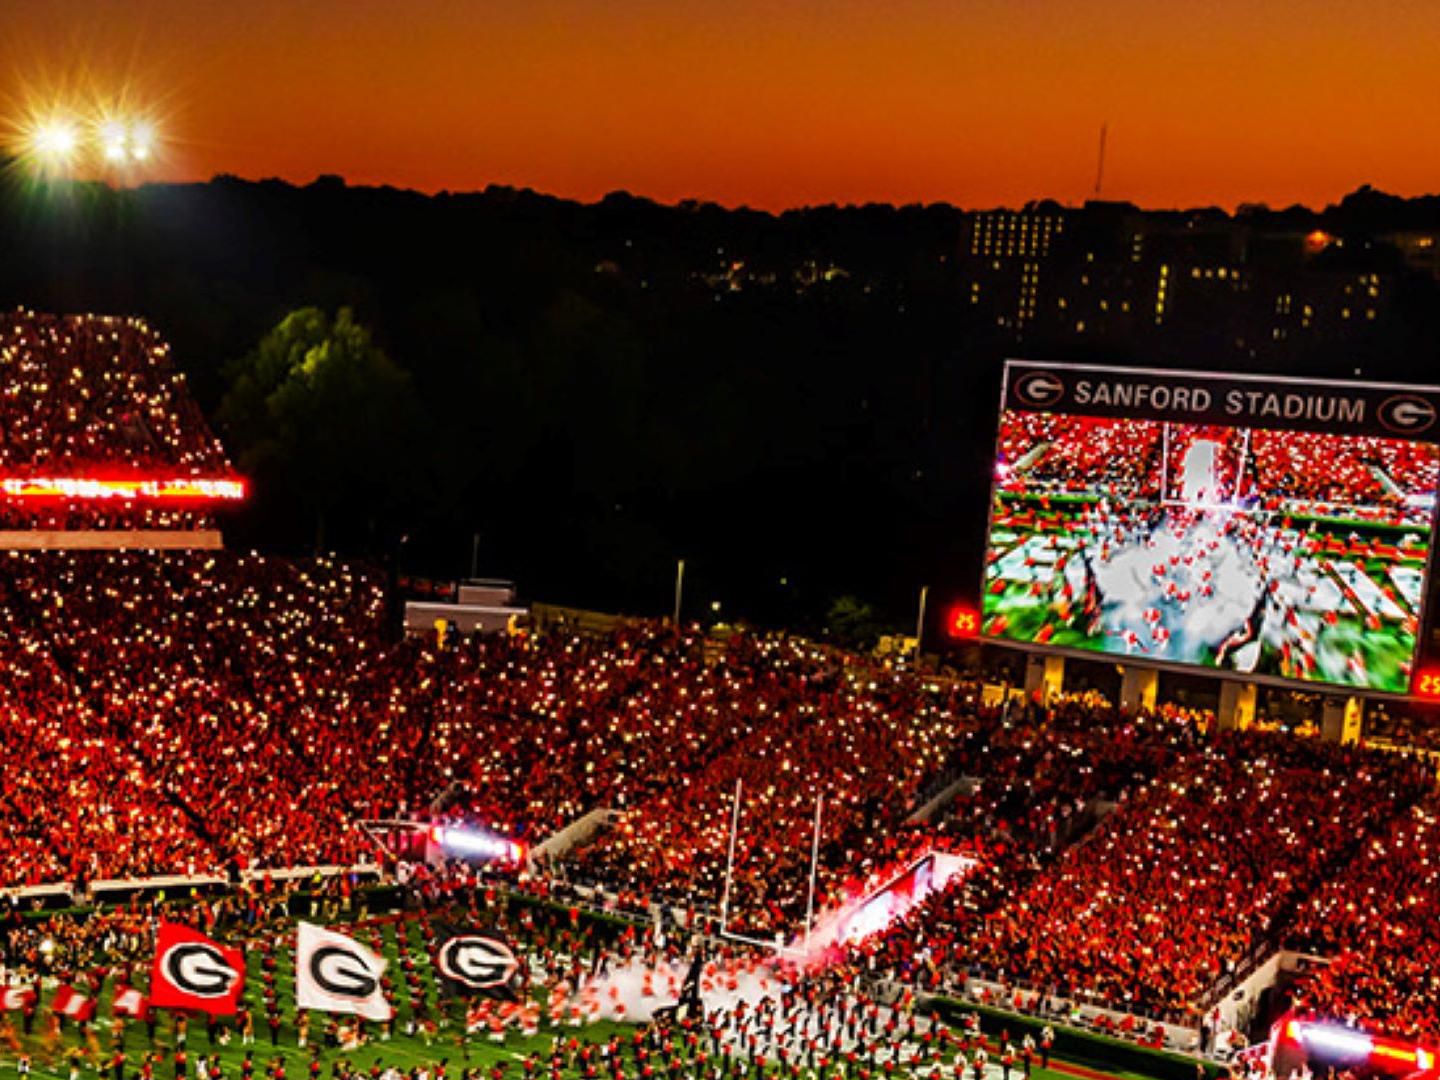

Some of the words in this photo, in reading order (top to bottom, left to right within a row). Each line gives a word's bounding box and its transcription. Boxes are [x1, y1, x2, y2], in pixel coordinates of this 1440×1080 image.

[1073, 381, 1212, 412] SANFORD
[1225, 391, 1366, 424] STADIUM
[166, 942, 238, 997] G
[311, 946, 378, 999] G
[440, 936, 519, 988] G
